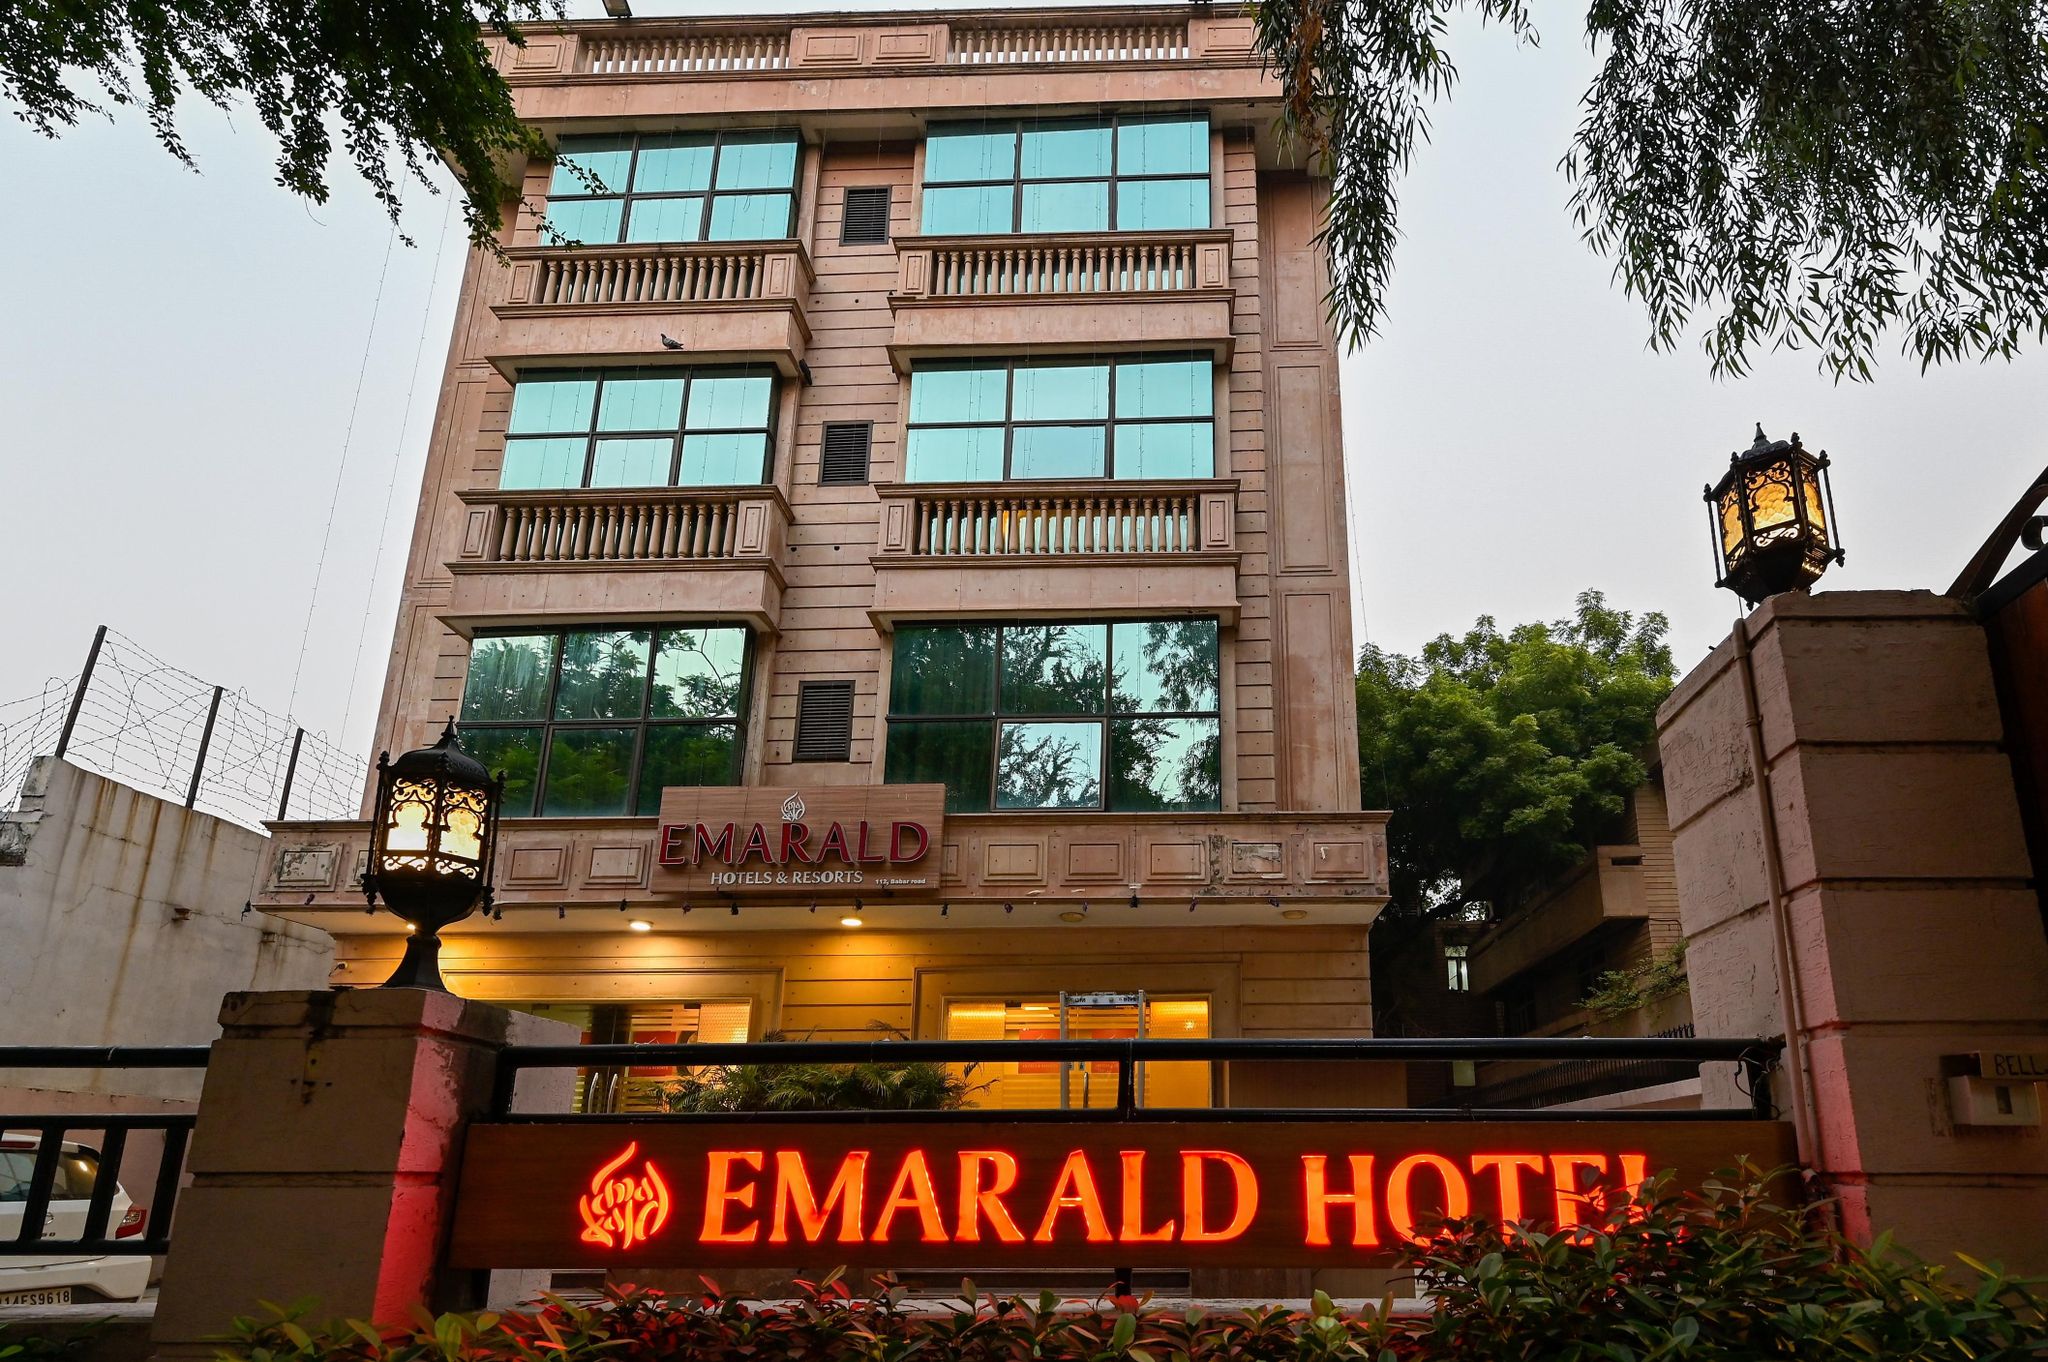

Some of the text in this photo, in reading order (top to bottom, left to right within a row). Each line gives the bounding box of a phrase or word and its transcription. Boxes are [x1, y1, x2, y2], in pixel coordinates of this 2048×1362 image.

[658, 820, 930, 865] EMARALD
[711, 870, 863, 885] HOTELS & RESORTS
[1994, 1053, 2047, 1076] BELL
[698, 1148, 1260, 1243] EMARALD
